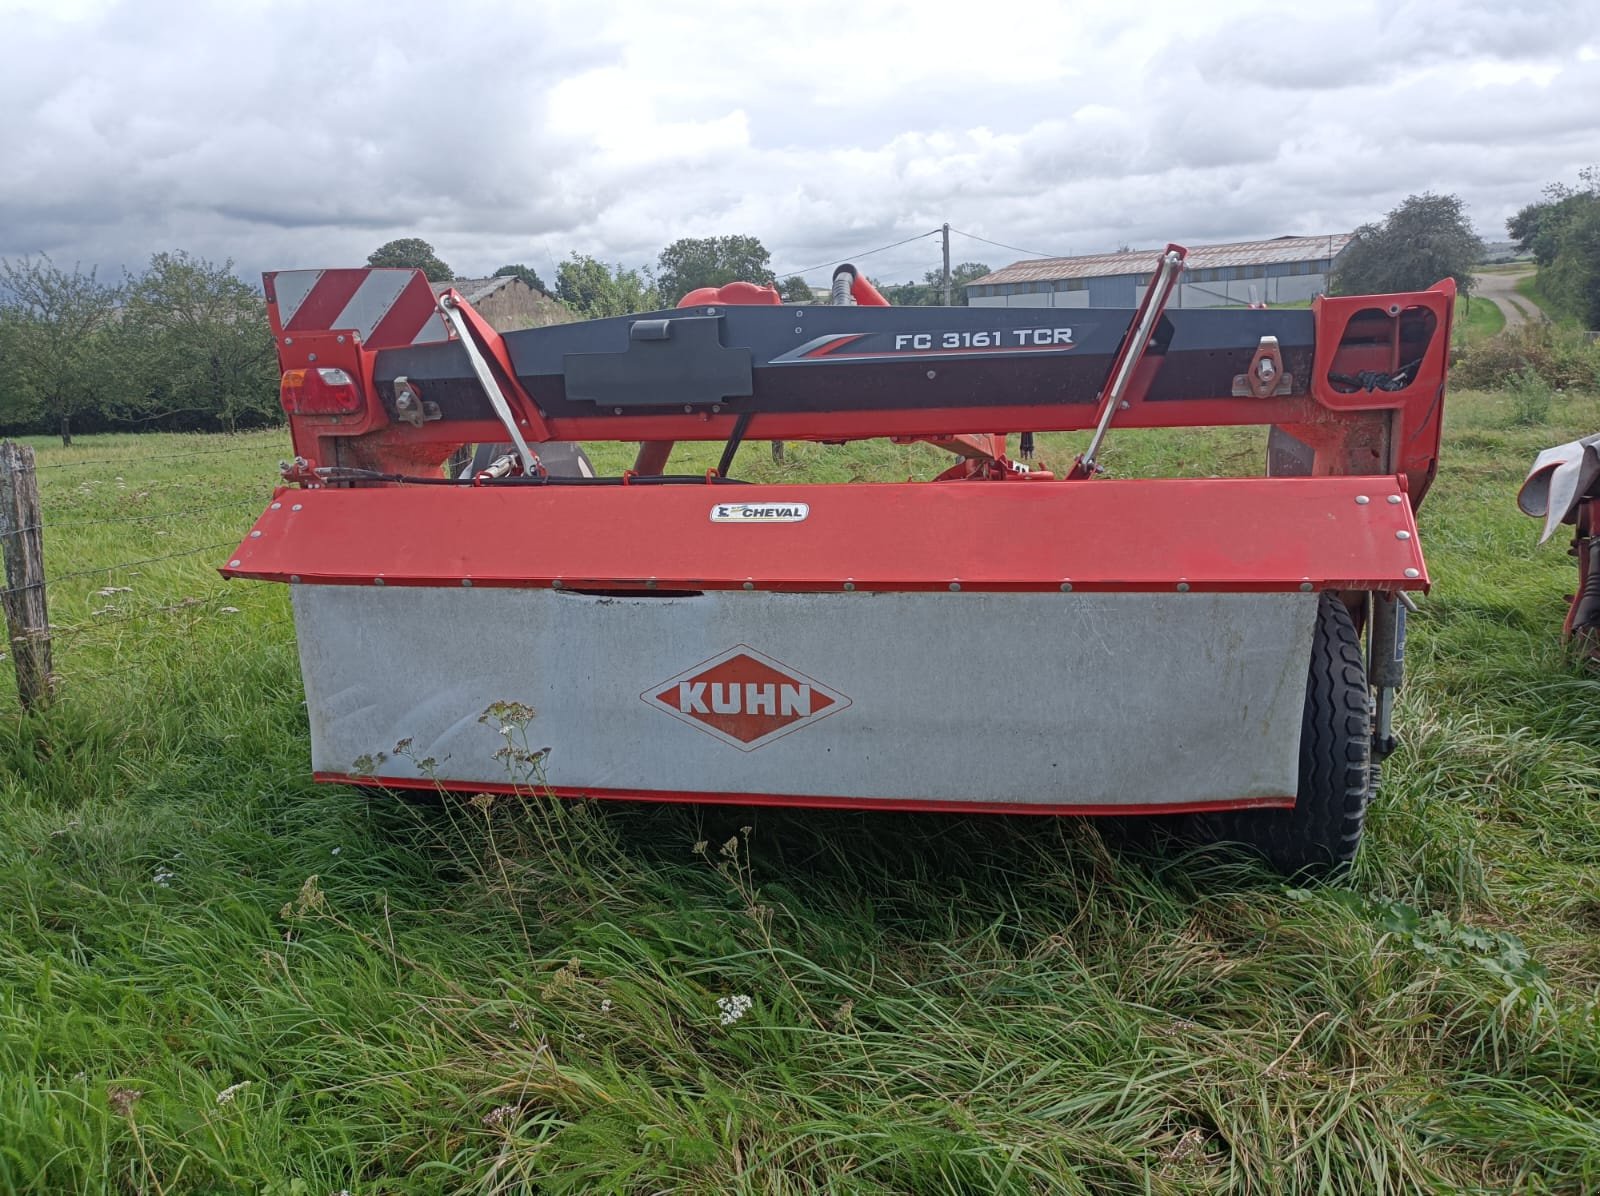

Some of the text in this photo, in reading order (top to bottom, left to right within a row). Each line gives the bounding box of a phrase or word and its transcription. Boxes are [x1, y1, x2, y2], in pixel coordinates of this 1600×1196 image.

[895, 328, 1073, 350] FC 3161 TCR
[742, 508, 802, 518] CHEVAL
[679, 681, 812, 717] KUHN
